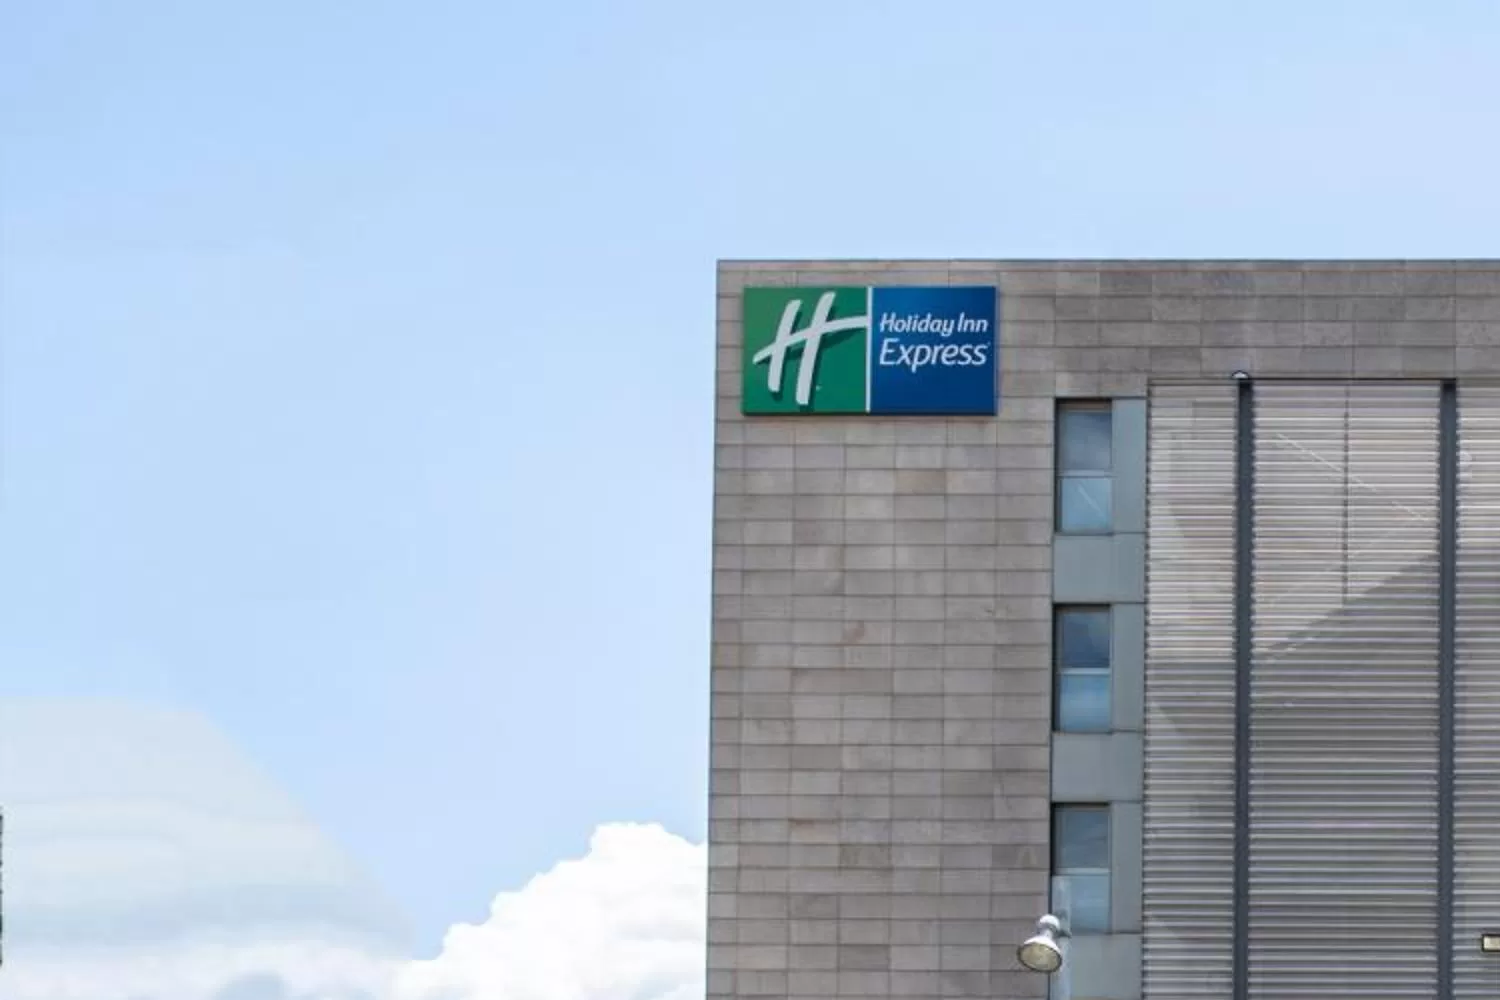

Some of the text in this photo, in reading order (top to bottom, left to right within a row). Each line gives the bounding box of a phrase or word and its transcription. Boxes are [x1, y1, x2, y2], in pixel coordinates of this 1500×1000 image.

[879, 312, 989, 337] Holiday Inn
[879, 337, 989, 373] Express
